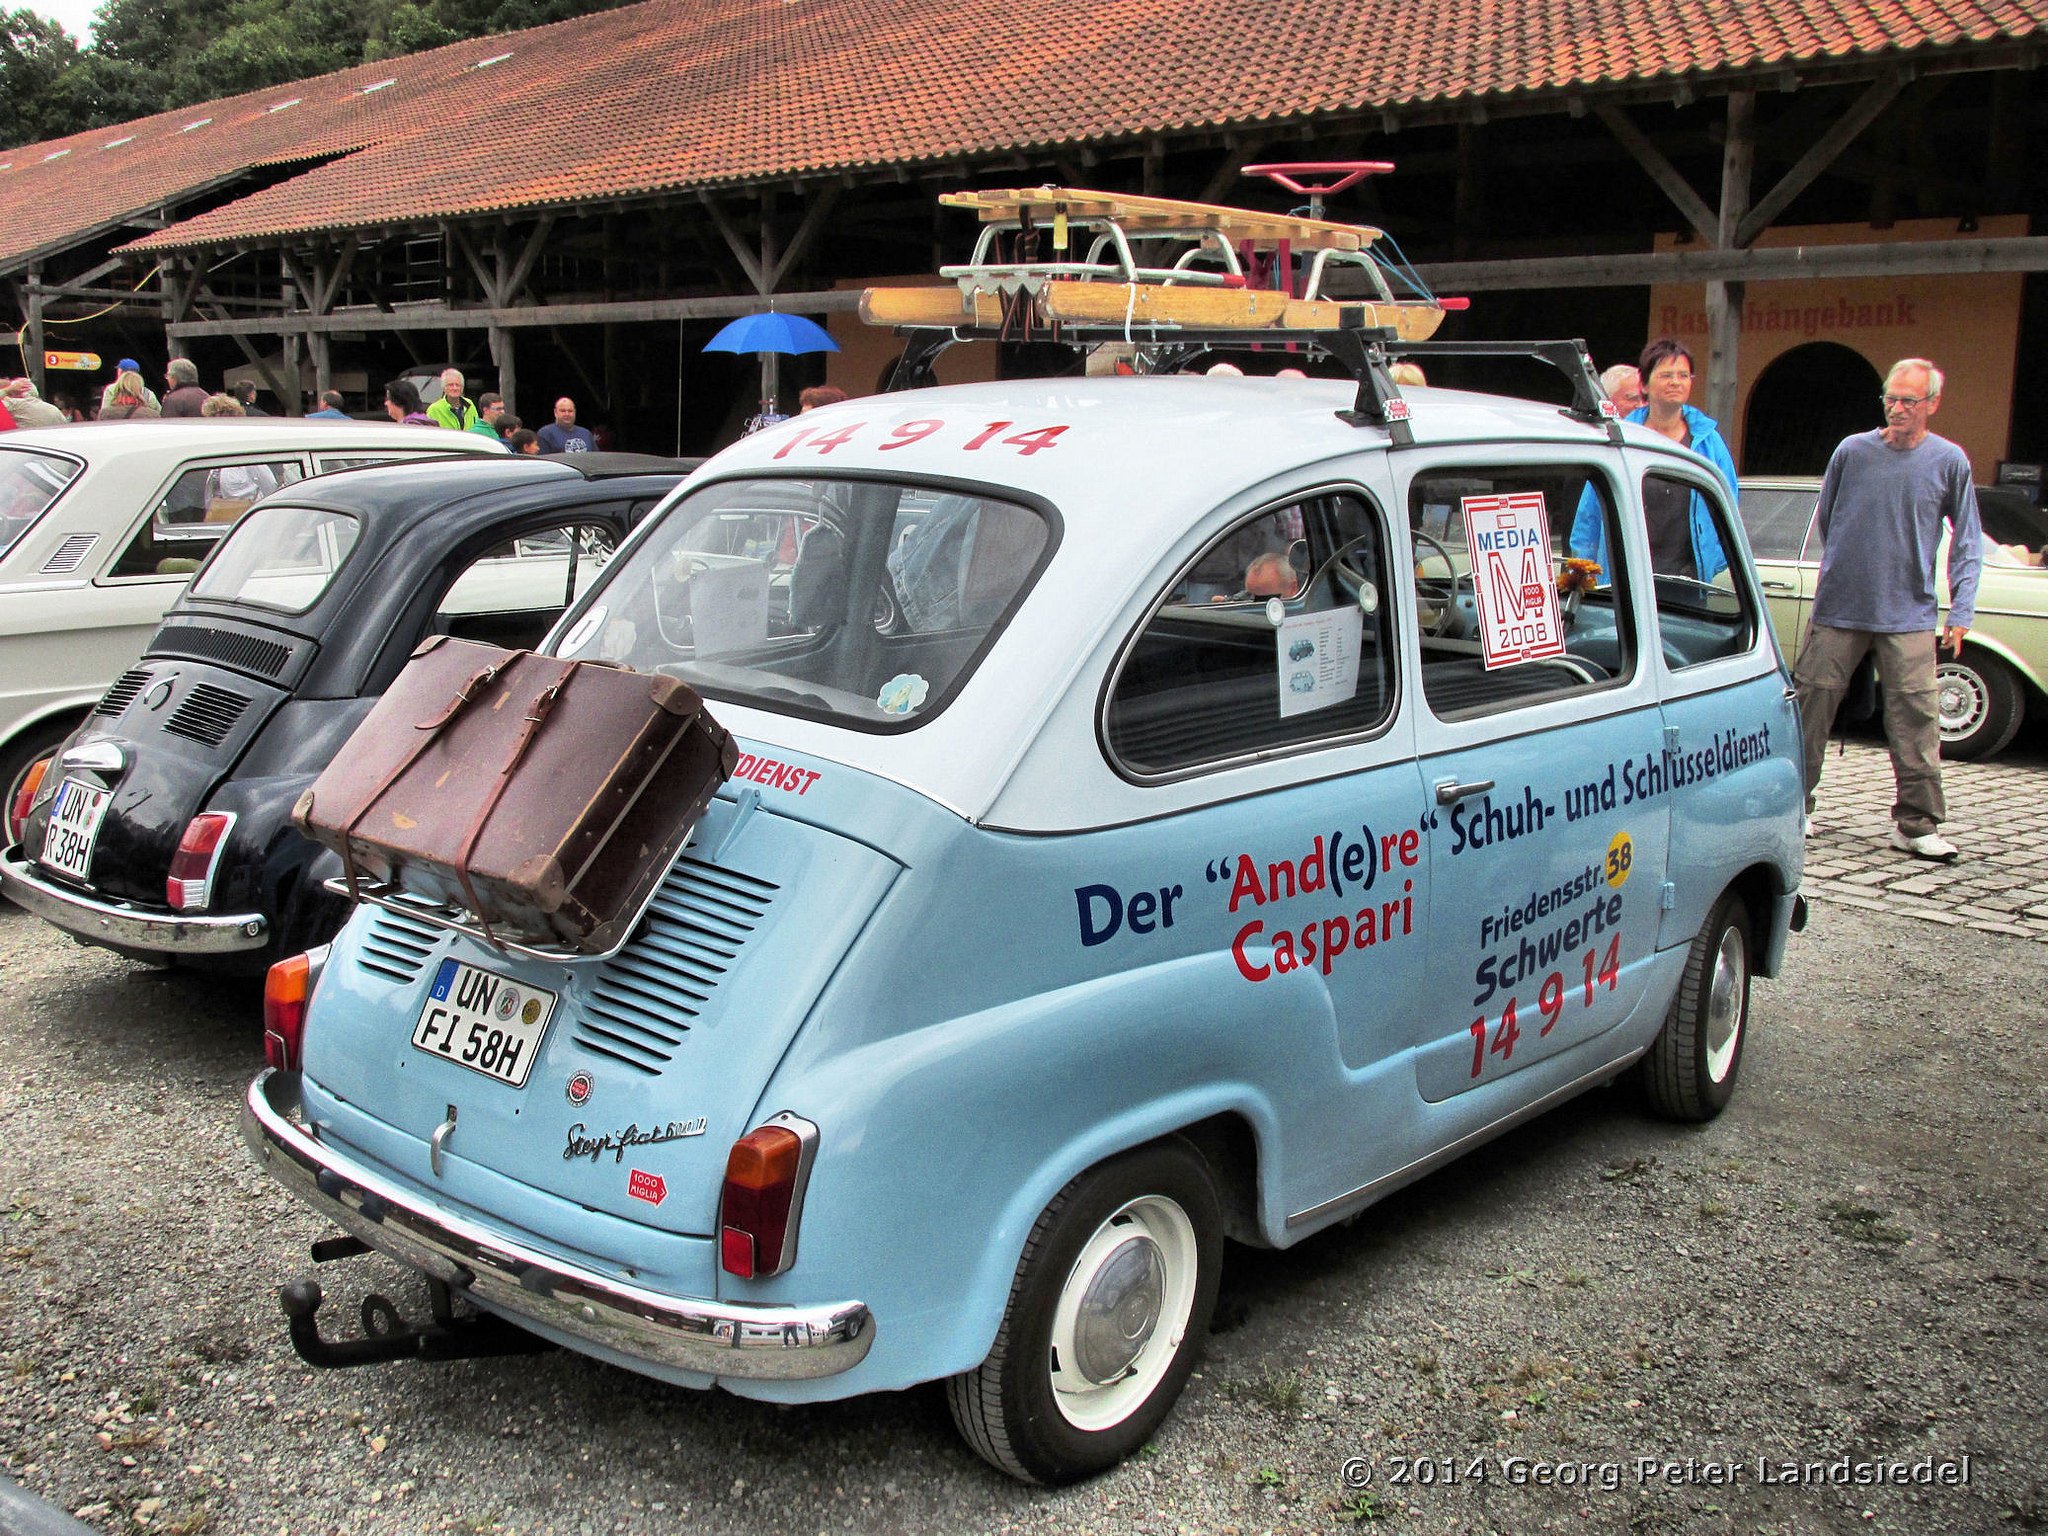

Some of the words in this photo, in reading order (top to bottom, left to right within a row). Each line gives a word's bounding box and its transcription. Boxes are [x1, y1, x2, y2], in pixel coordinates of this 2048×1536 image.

[1660, 294, 1917, 335] Rashängebank
[772, 421, 868, 460] 14
[878, 419, 946, 451] 9
[962, 421, 1071, 456] 14
[1477, 528, 1540, 551] MEDIA
[1500, 622, 1548, 649] 2008
[62, 786, 89, 825] UN
[45, 823, 58, 859] R
[56, 828, 90, 872] 38H
[1074, 883, 1184, 947] Der
[1450, 785, 1556, 856] Schuh-
[1565, 763, 1617, 823] und
[1622, 722, 1772, 806] Schlüsseldienst
[1480, 864, 1604, 950] Friedensstr.
[1607, 841, 1633, 880] 38
[1230, 879, 1414, 983] Caspari
[1473, 893, 1623, 1008] Schwerte
[436, 985, 445, 998] D
[456, 968, 500, 1016] UN
[1470, 996, 1521, 1079] 14
[1537, 971, 1565, 1038] 9
[1582, 931, 1621, 1009] 14
[420, 1007, 461, 1054] FI
[462, 1022, 524, 1077] 58H
[630, 1184, 659, 1200] MIGLIA
[634, 1173, 659, 1188] 1000
